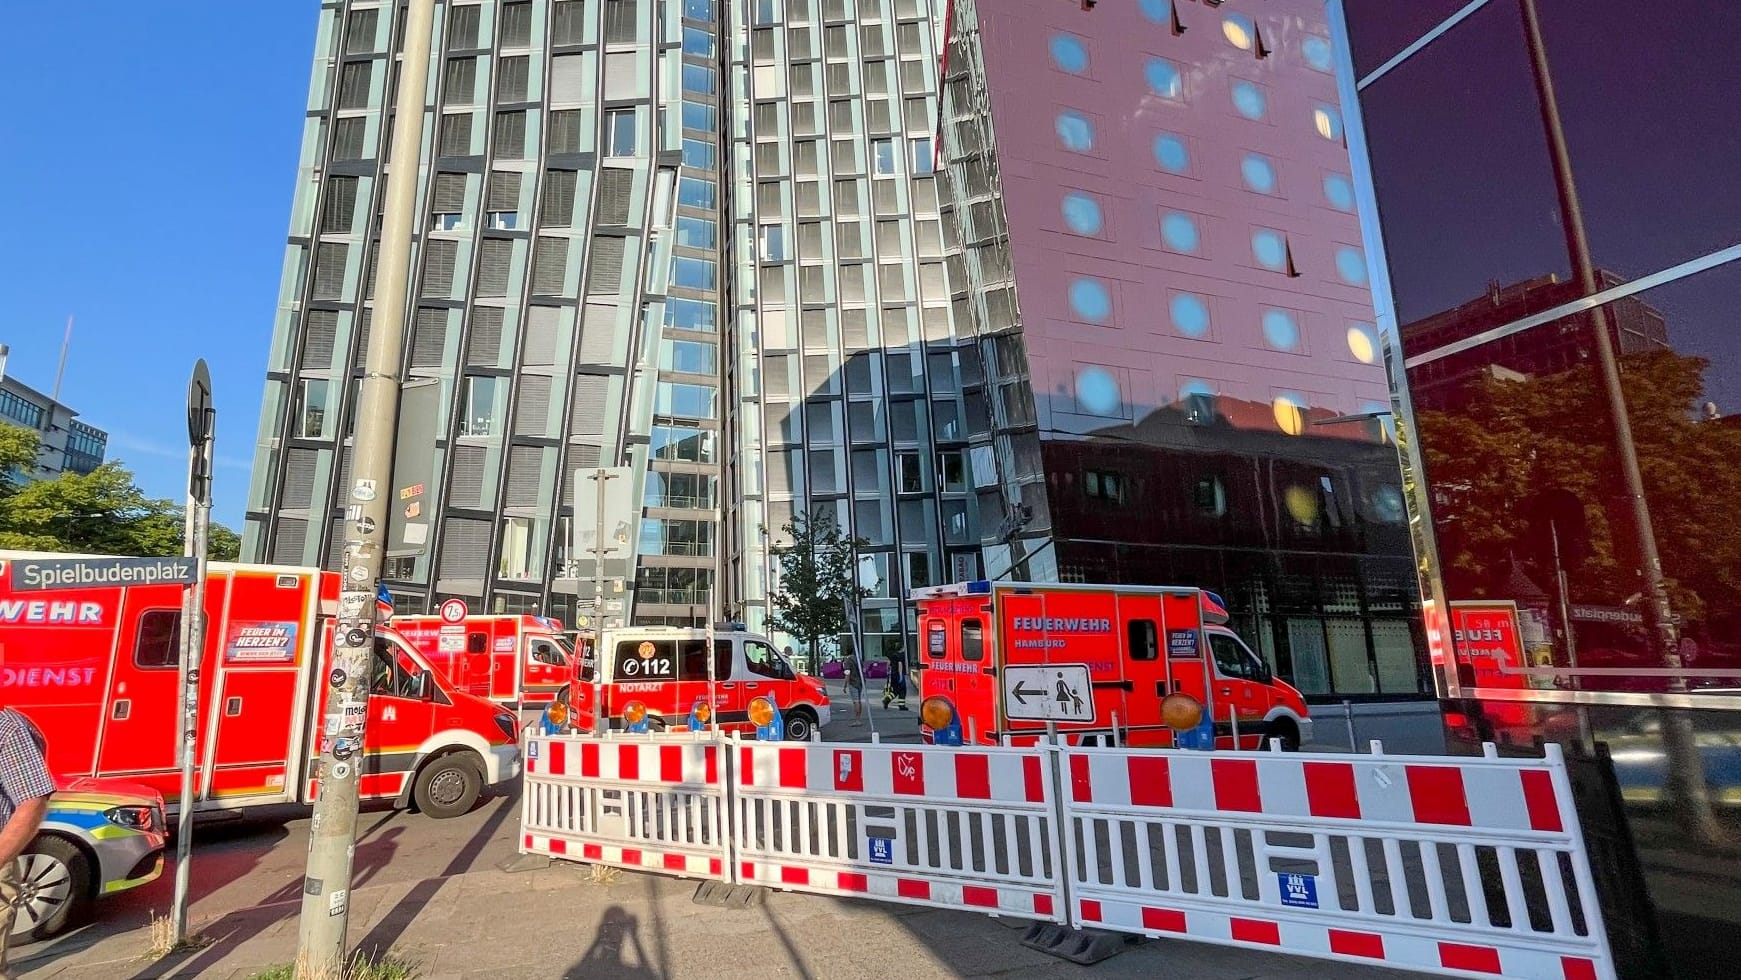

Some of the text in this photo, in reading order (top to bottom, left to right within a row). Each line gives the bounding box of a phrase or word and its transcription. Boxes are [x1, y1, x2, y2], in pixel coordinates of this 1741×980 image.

[23, 562, 189, 588] Spielbudenplatz
[1013, 617, 1111, 631] FEUERWEHR
[240, 627, 286, 637] FEUER IM
[235, 636, 289, 647] HERZEN?
[1014, 639, 1066, 649] HAMBURG
[641, 659, 670, 675] 112
[931, 662, 978, 674] FEUERWEHR
[1, 667, 97, 687] DIENST
[619, 682, 664, 693] NOTARZT
[1286, 884, 1309, 894] VVL
